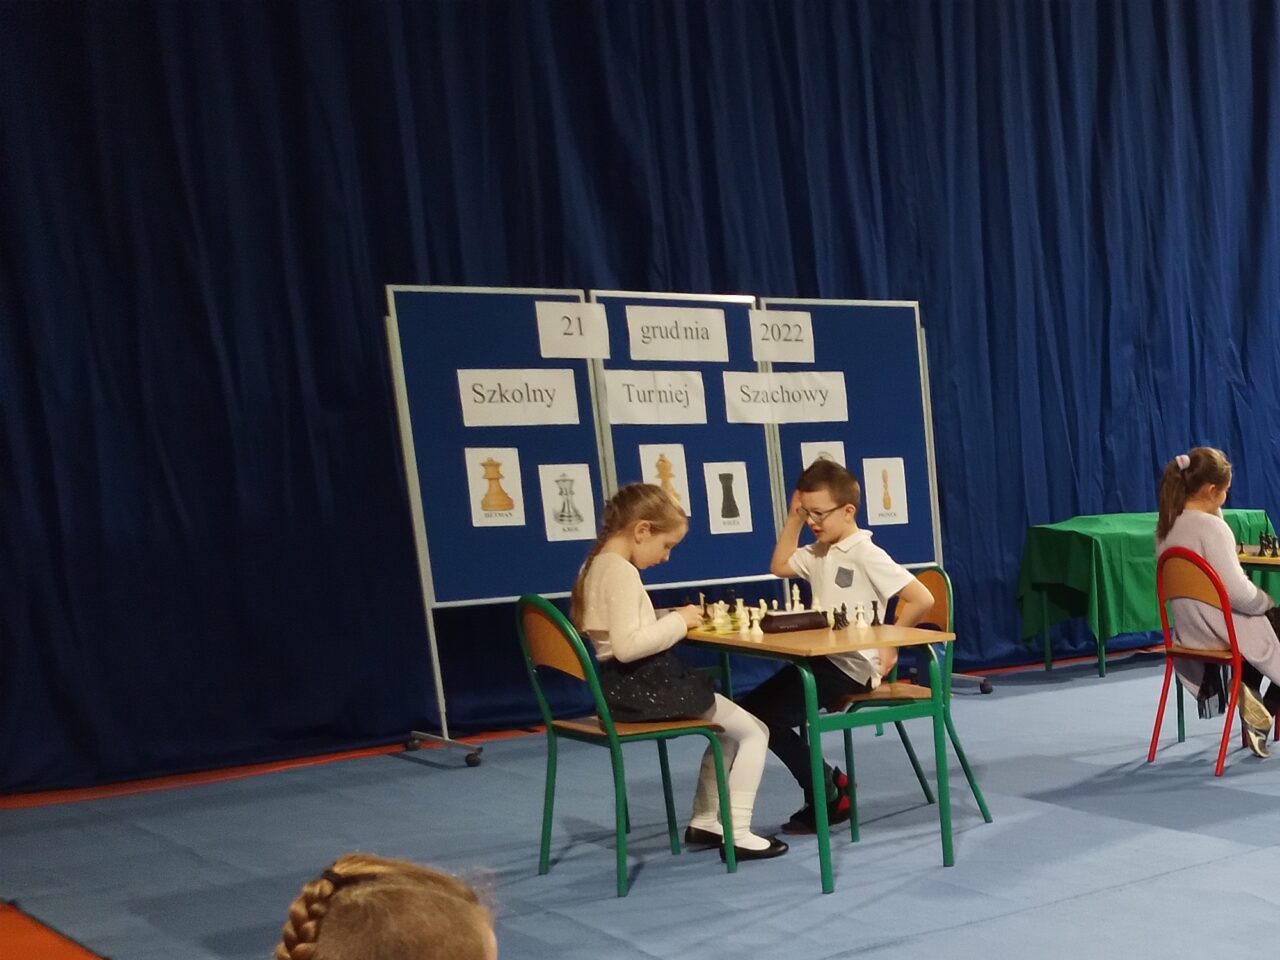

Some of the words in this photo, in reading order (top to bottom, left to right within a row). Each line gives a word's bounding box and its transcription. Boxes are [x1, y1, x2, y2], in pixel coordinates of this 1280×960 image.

[561, 316, 585, 337] 21
[640, 319, 711, 344] grudnia
[760, 323, 805, 343] 2022
[471, 382, 557, 408] Szkolny
[622, 383, 691, 407] Turniej
[739, 384, 830, 406] Szachowy
